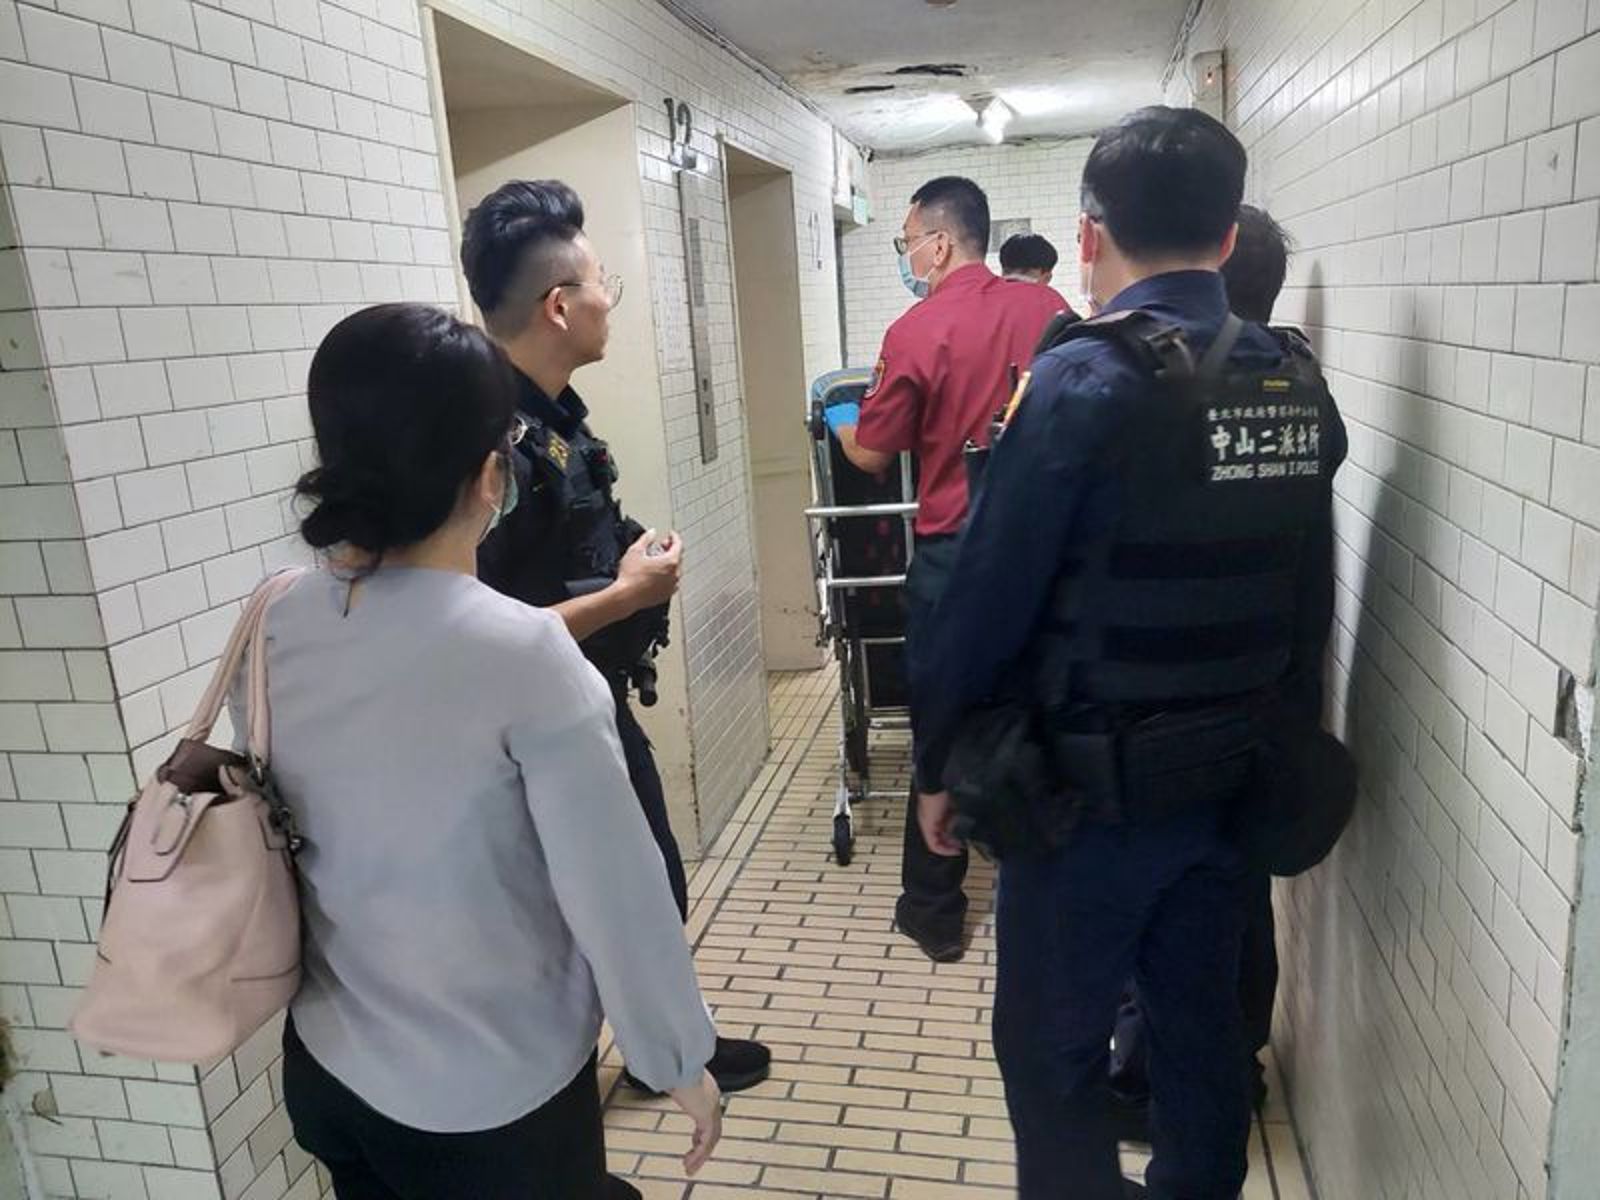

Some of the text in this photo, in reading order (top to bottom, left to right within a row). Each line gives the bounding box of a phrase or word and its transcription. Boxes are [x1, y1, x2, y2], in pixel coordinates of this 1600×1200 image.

[663, 97, 697, 169] 12
[1210, 423, 1319, 461] 中山二派出所
[1211, 463, 1255, 480] ZHONG
